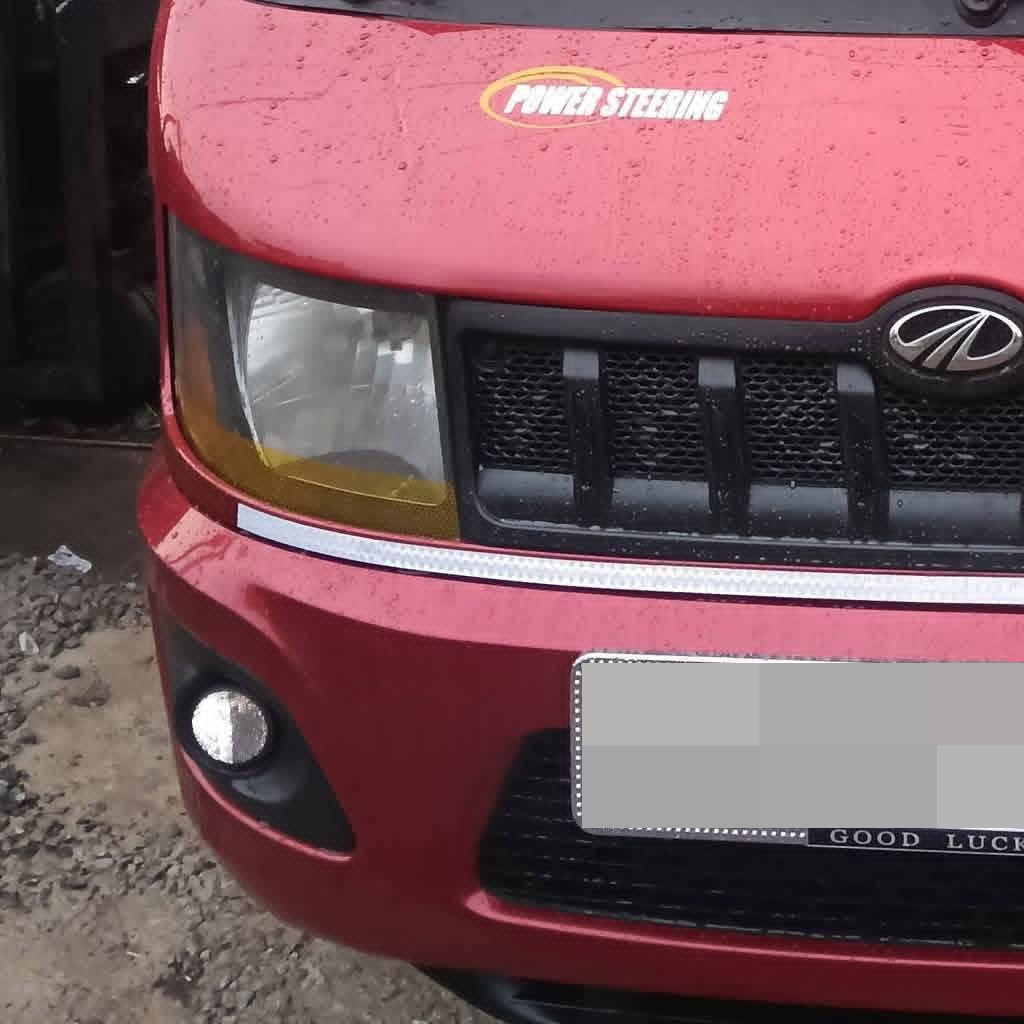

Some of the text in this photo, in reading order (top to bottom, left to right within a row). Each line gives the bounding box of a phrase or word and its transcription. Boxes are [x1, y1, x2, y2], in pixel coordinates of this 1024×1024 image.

[504, 84, 729, 121] POWER STEERING
[830, 828, 920, 848] GOOD
